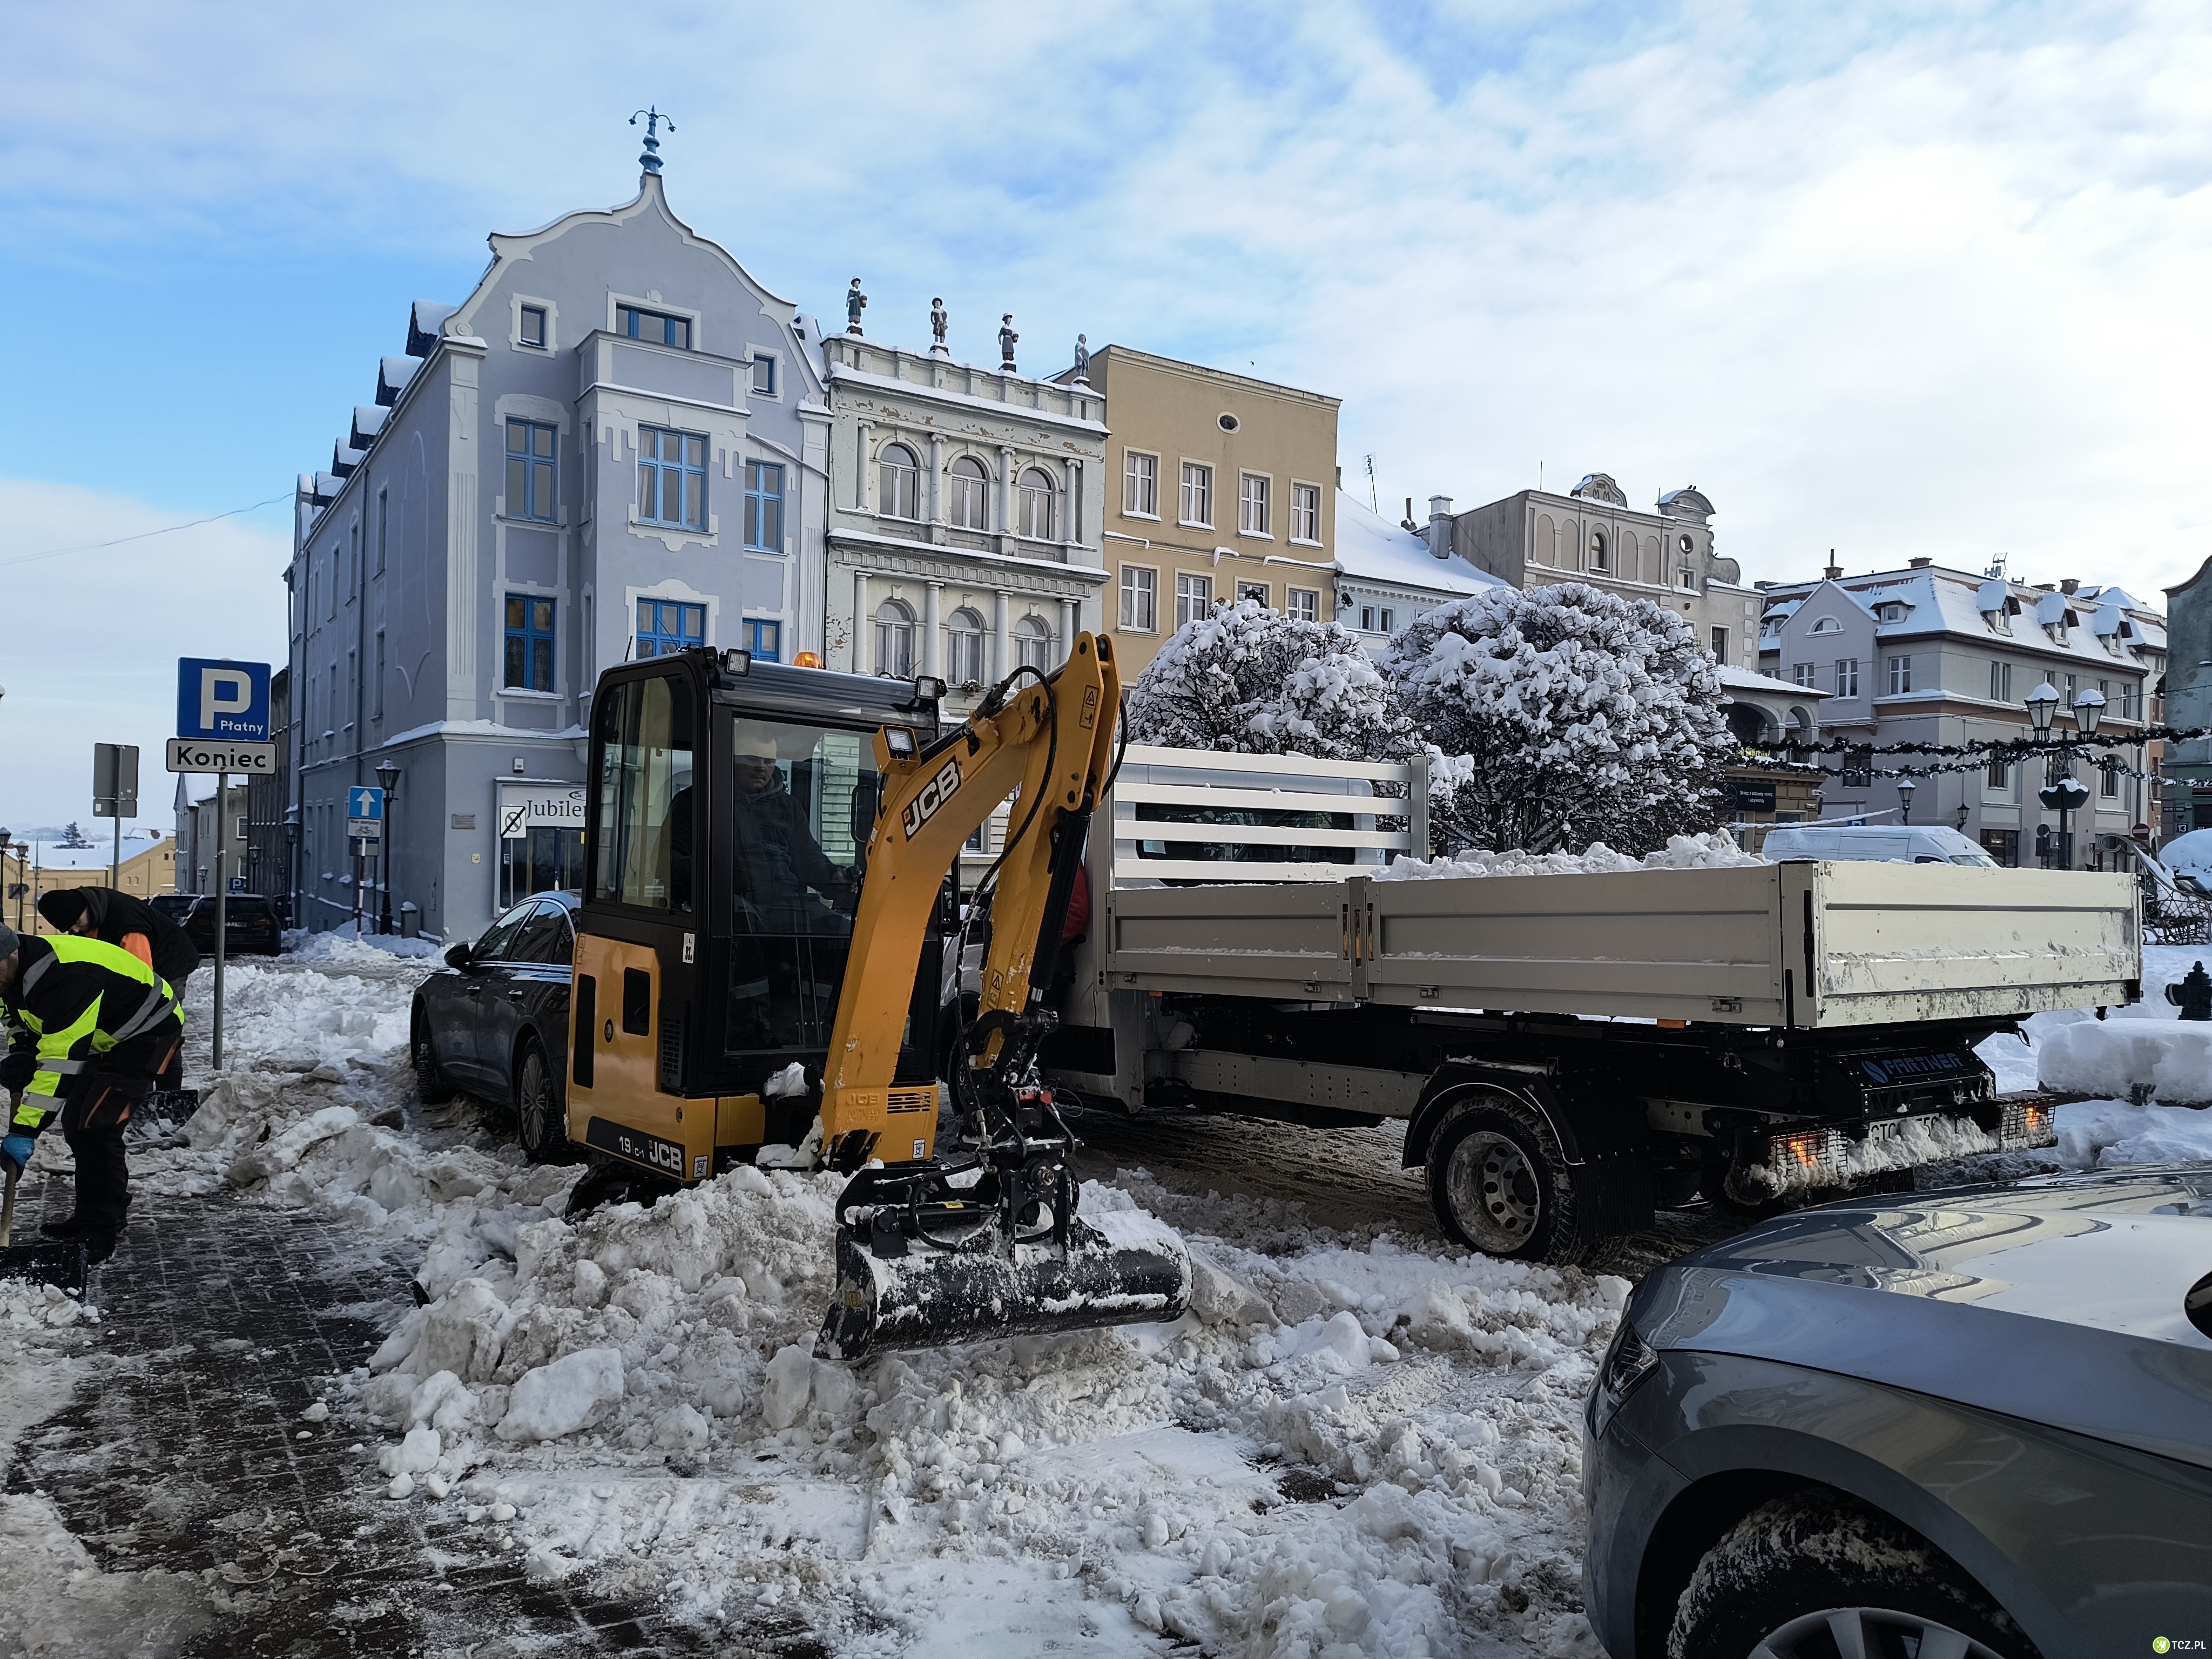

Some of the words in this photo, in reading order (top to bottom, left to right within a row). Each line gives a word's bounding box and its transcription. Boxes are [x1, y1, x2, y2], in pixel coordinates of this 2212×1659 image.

[200, 667, 252, 729] P
[220, 720, 264, 735] Płatny
[177, 746, 266, 768] Koniec
[906, 761, 959, 836] JCB
[2177, 824, 2187, 832] 13
[233, 879, 241, 889] P
[1881, 1053, 1964, 1075] PARTNER
[649, 1141, 683, 1171] JCB
